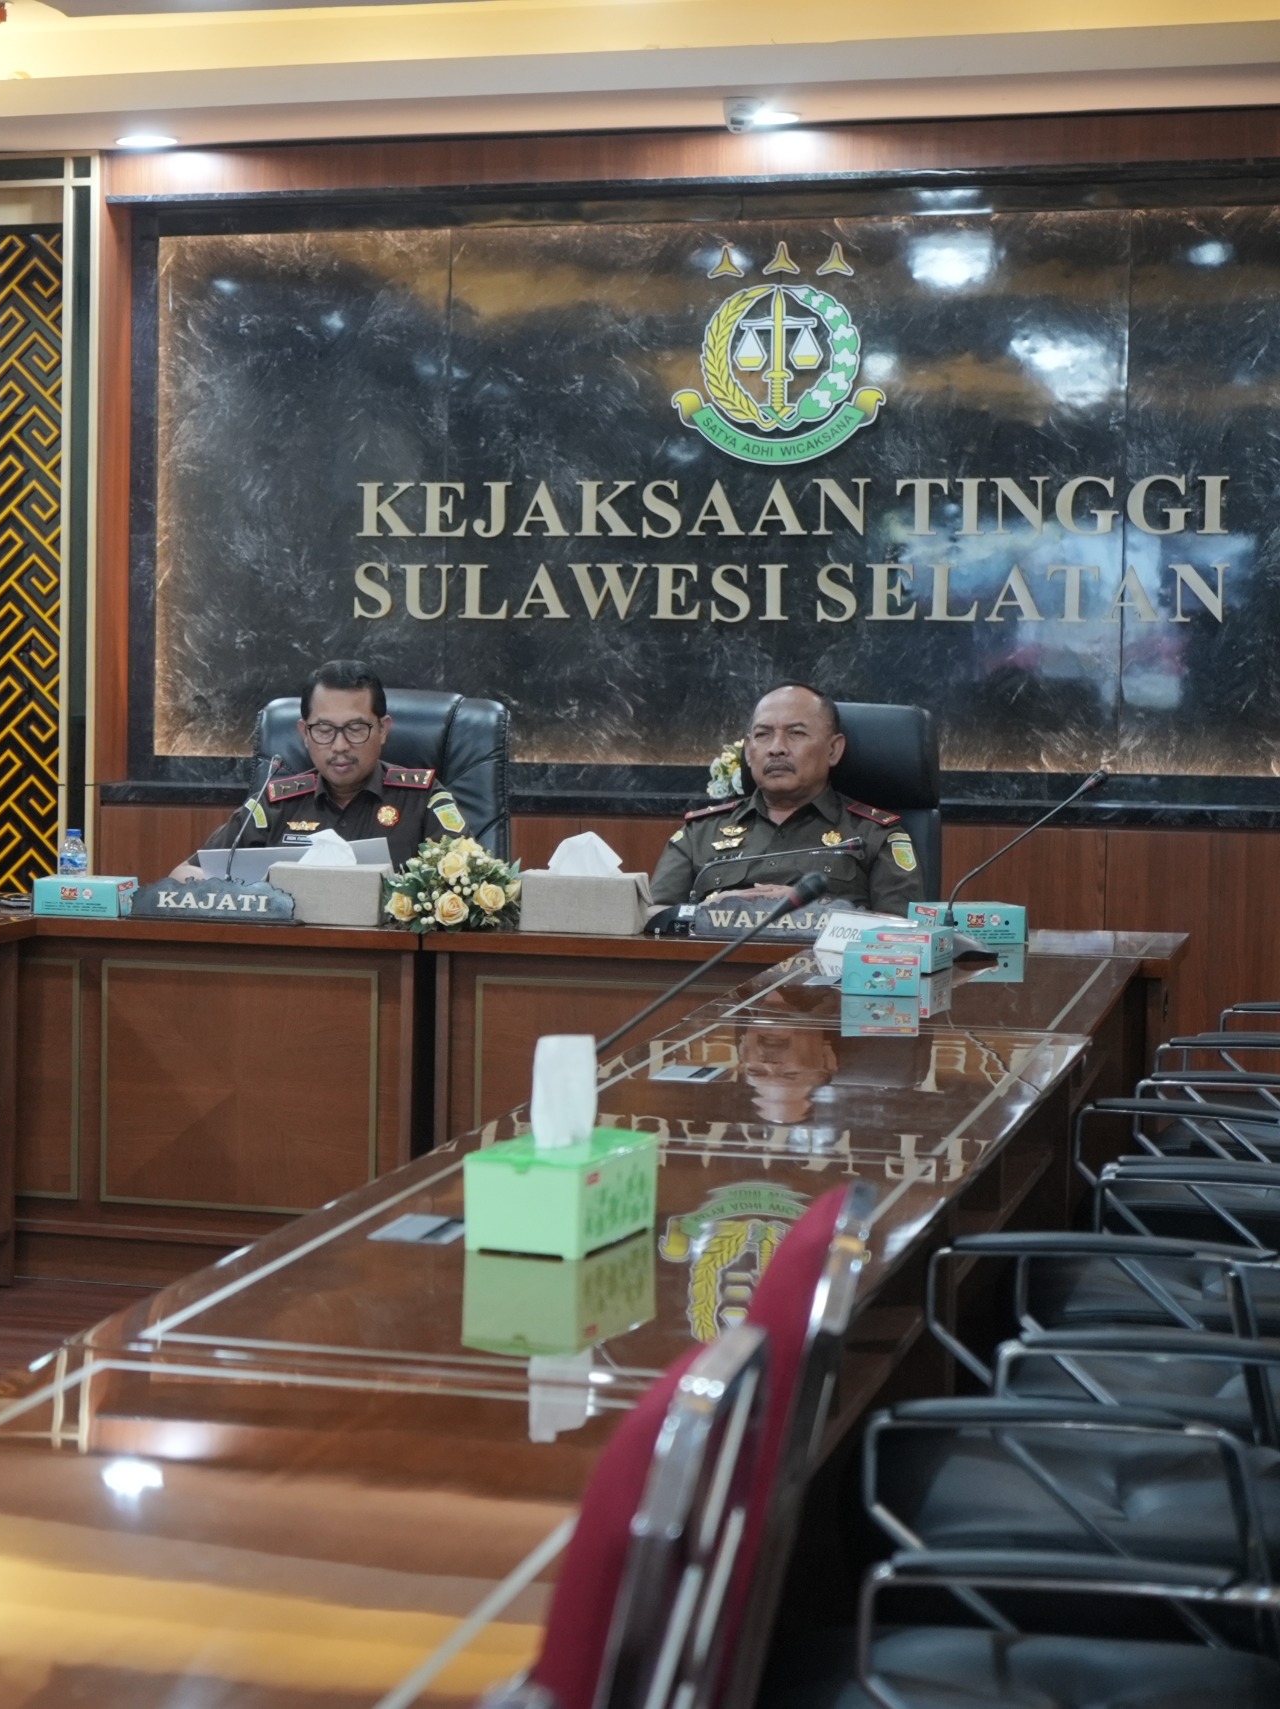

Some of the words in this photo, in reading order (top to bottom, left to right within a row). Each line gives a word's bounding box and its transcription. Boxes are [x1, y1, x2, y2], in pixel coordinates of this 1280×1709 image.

[702, 417, 737, 449] SATYA
[743, 443, 773, 457] ADHI
[780, 414, 854, 457] WICAKSANA
[356, 478, 872, 540] KEJAKSAAN
[895, 474, 1231, 537] TINGGI
[353, 562, 789, 623] SULAWESI
[816, 562, 1231, 624] SELATAN
[156, 891, 269, 913] KAJATI
[708, 909, 830, 930] WAKAJA
